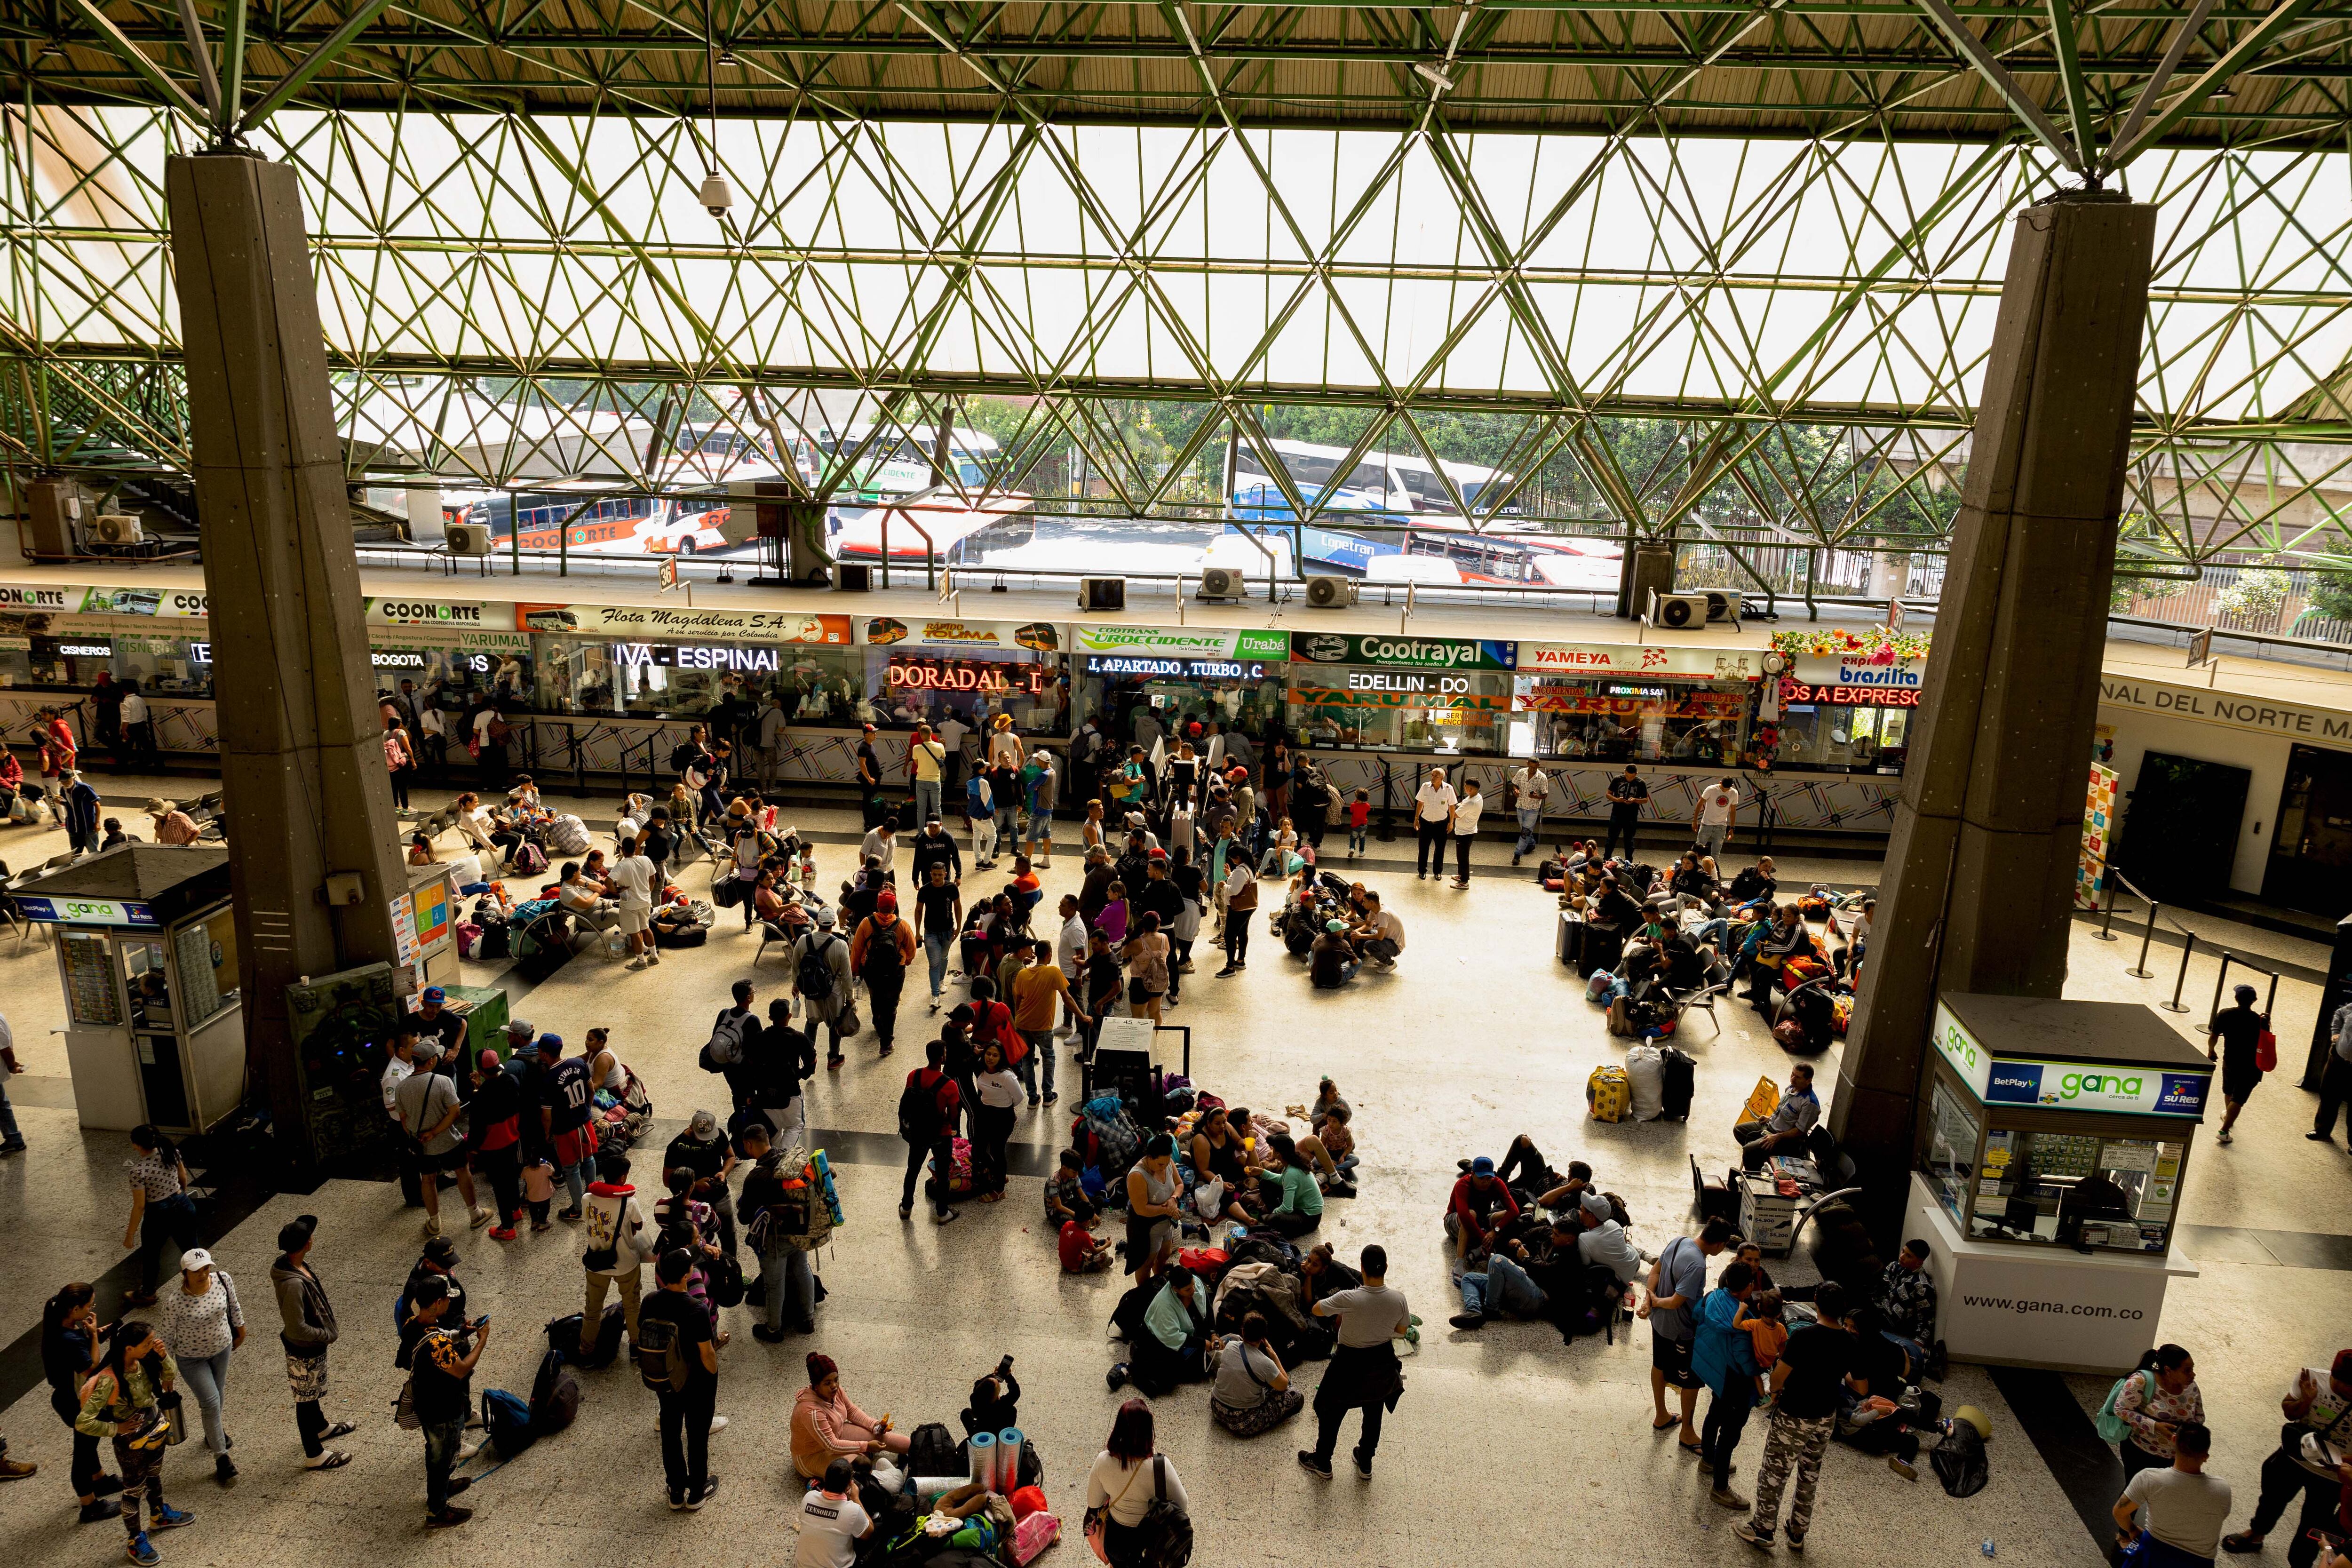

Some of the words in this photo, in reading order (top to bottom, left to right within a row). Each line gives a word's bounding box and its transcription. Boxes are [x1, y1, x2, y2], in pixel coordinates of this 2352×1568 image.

[1320, 533, 1375, 556] Copetran
[660, 565, 671, 586] 36
[383, 603, 480, 621] COONORTE
[601, 608, 646, 624] Flota
[651, 610, 745, 629] Magdalena
[750, 614, 787, 629] S.A.
[1894, 608, 1904, 630] 31
[739, 629, 779, 638] Colombia
[926, 622, 964, 631] RÁPIDO
[461, 633, 529, 648] YARUMAL
[922, 629, 999, 641] TOLIMA
[1095, 633, 1227, 647] UROCCIDENTE
[60, 645, 111, 656] CISNEROS
[118, 642, 180, 656] CISNEROS
[1242, 637, 1286, 651] Urabá
[1534, 643, 1582, 653] Transportes
[2190, 638, 2203, 661] 30
[1360, 637, 1481, 667] Cootrayal
[1535, 651, 1611, 665] YAMEYA
[372, 653, 424, 667] BOGOTA
[1102, 658, 1181, 675] APARTADO
[1191, 662, 1241, 677] TURBO
[890, 666, 1009, 689] DORADAL
[1840, 666, 1918, 685] brasilia
[1349, 674, 1424, 692] EDELLIN
[1440, 677, 1469, 693] DO
[1531, 685, 1585, 696] ENCOMIENDAS
[1610, 686, 1648, 695] PROXIMA
[1296, 689, 1504, 710] YARUMAL
[1690, 692, 1743, 703] TIQUETES
[1814, 687, 1829, 701] A
[1515, 695, 1744, 720] YARUMAL
[2155, 691, 2205, 715] DEL
[2214, 701, 2314, 732] NORTE
[1443, 718, 1493, 727] ENCOMIENDAS
[1446, 712, 1479, 720] SERVICIO
[1123, 854, 1137, 866] FOX
[419, 899, 423, 907] 1
[433, 892, 437, 900] 2
[66, 902, 113, 917] gana
[420, 919, 425, 927] 3
[431, 990, 441, 998] C
[1947, 1026, 1976, 1069] gana
[557, 1067, 573, 1085] NEYMAR
[1994, 1078, 2028, 1088] BetPlay
[2059, 1073, 2143, 1100] gana
[564, 1079, 586, 1109] 10
[1963, 1295, 2143, 1321] www.gana.com.co
[704, 1484, 714, 1494] HOKA
[806, 1504, 837, 1518] CENSORED
